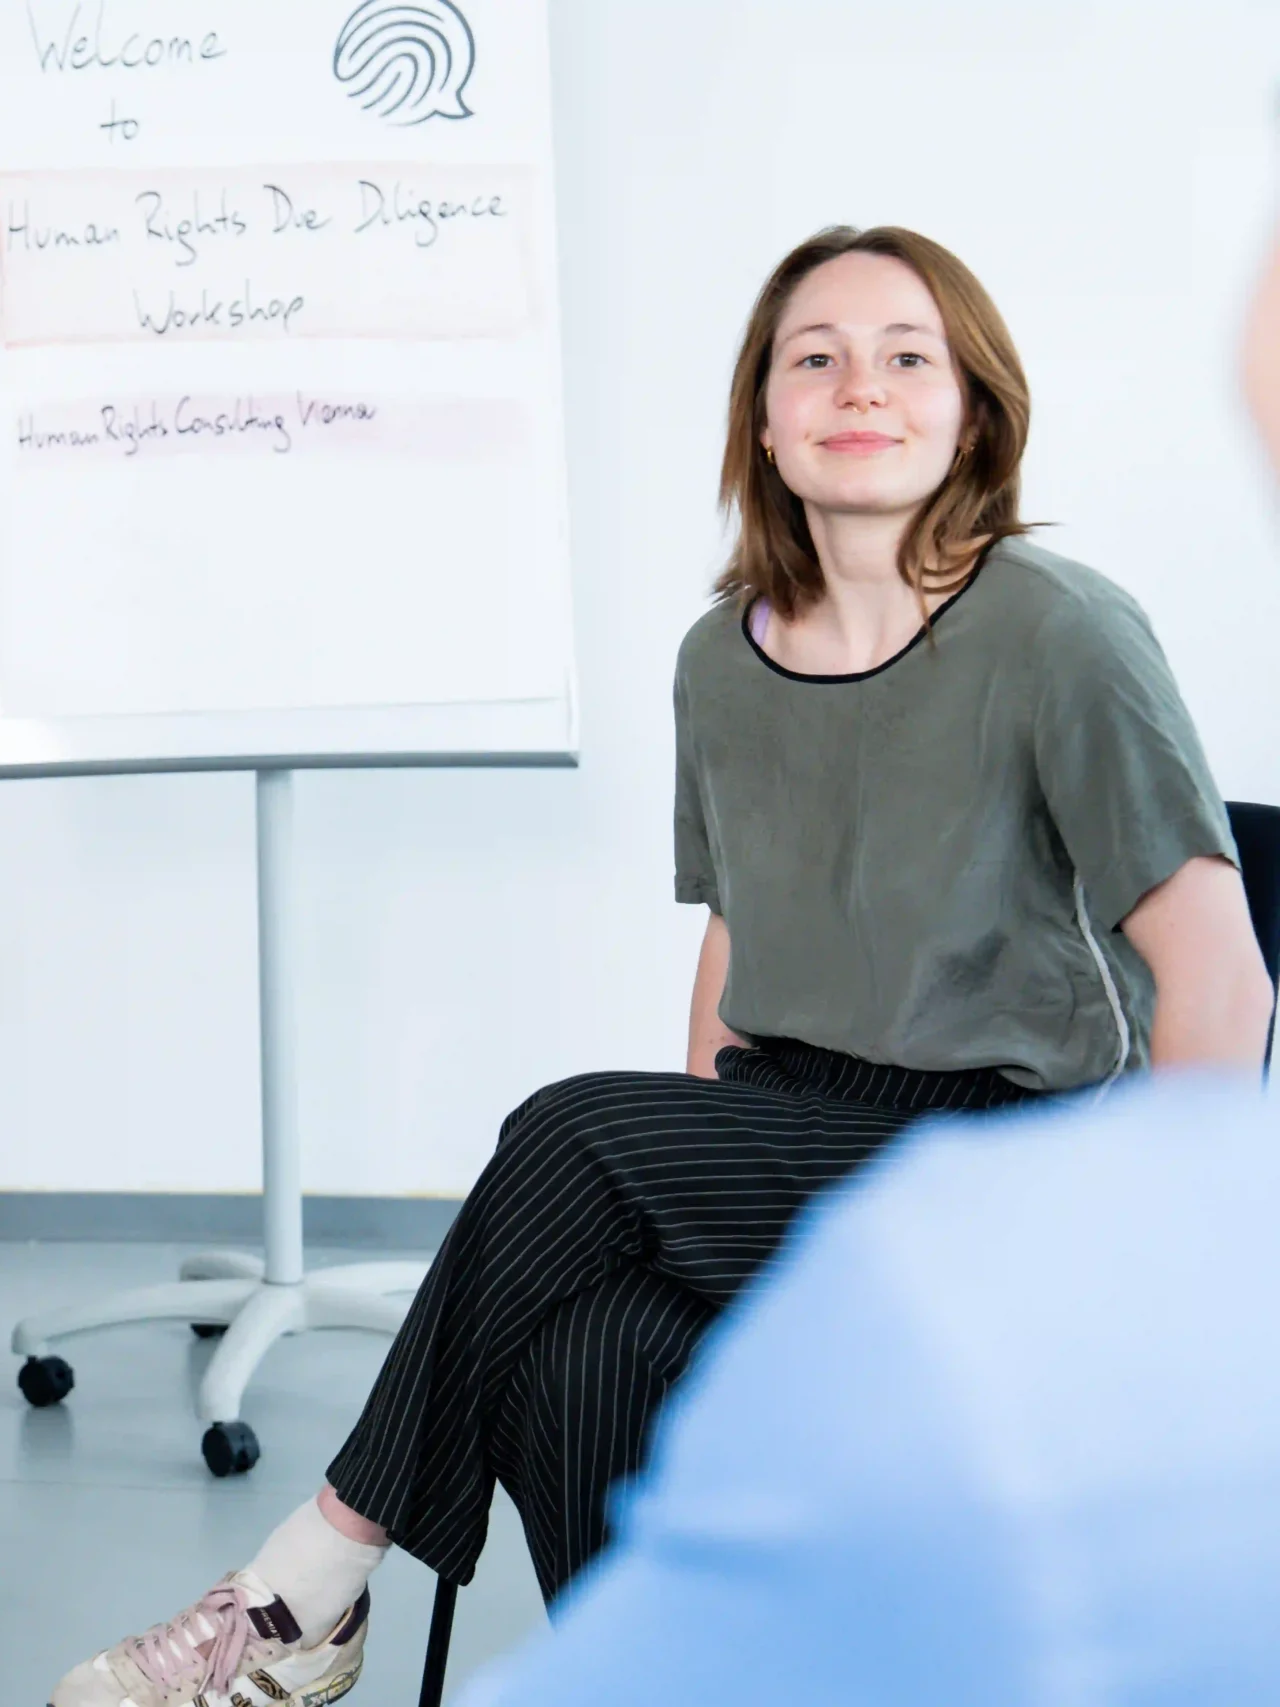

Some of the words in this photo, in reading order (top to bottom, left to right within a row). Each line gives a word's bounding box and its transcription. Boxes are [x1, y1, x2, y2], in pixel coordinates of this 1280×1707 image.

[27, 0, 227, 73] Welcome
[100, 99, 139, 142] to
[7, 197, 120, 251] Human
[135, 188, 248, 267] Rights
[263, 184, 333, 232] Due
[358, 180, 508, 247] Diligence
[132, 278, 306, 335] Workshop
[297, 390, 377, 428] Vienna
